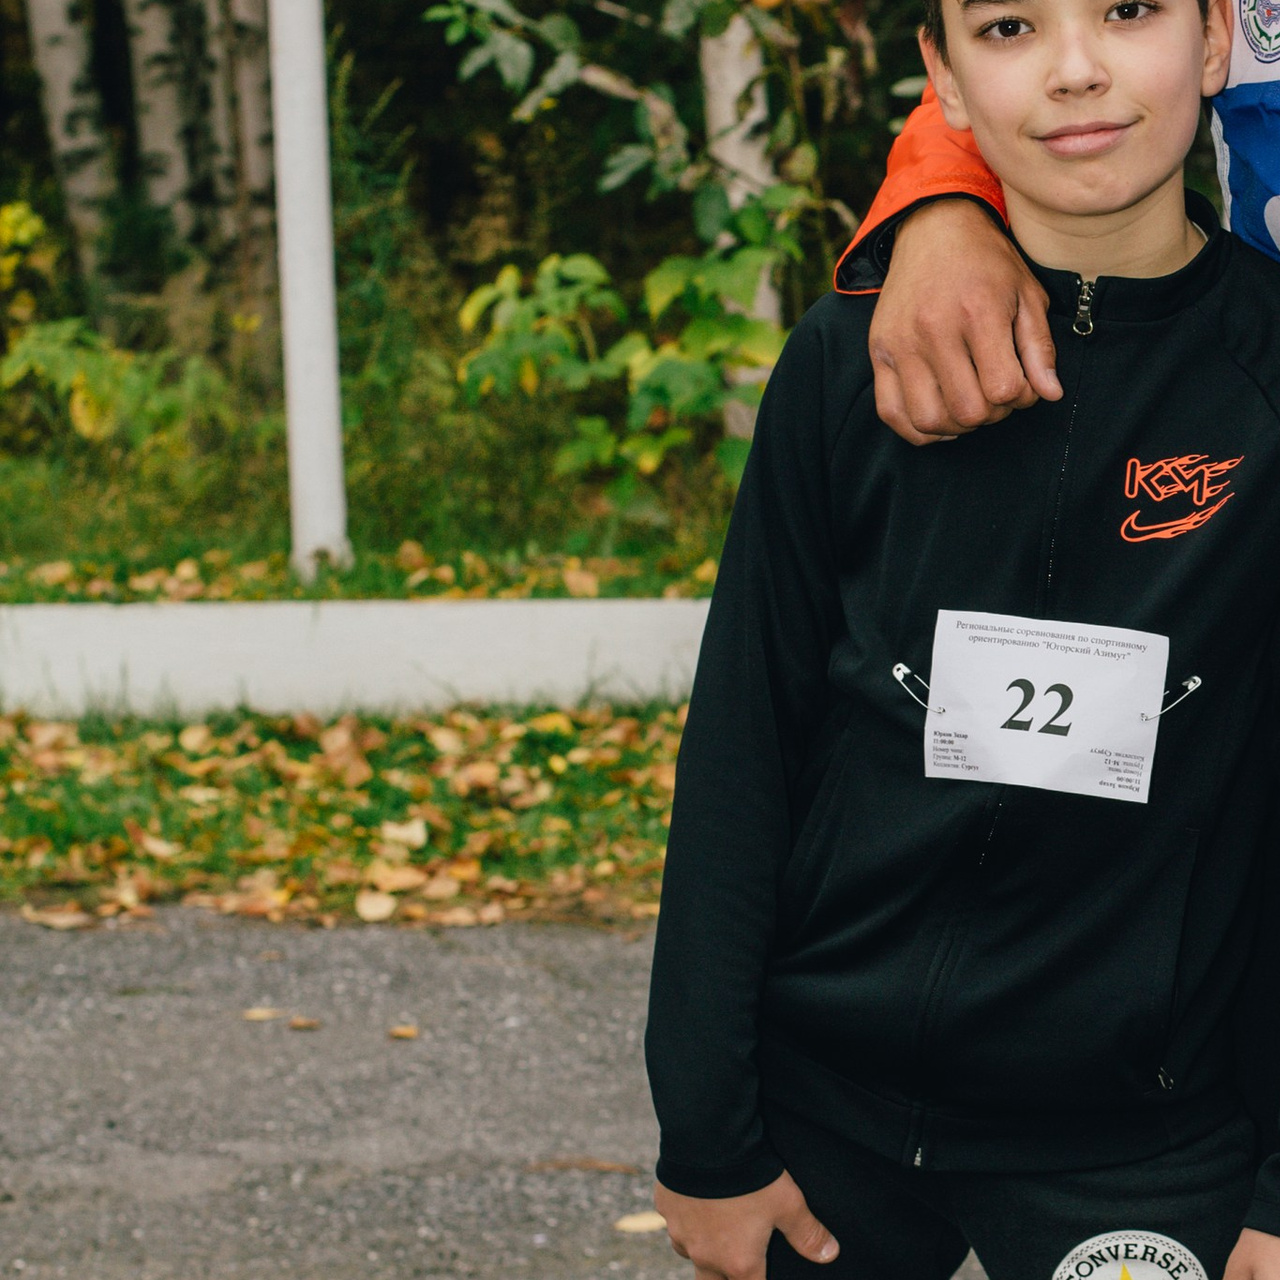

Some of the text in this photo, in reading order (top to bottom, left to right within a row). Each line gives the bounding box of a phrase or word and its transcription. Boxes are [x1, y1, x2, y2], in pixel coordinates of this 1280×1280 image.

[956, 621, 1148, 653] Региональные соревнования по спортивному
[968, 635, 1040, 648] ориентированию
[1000, 678, 1073, 737] 22
